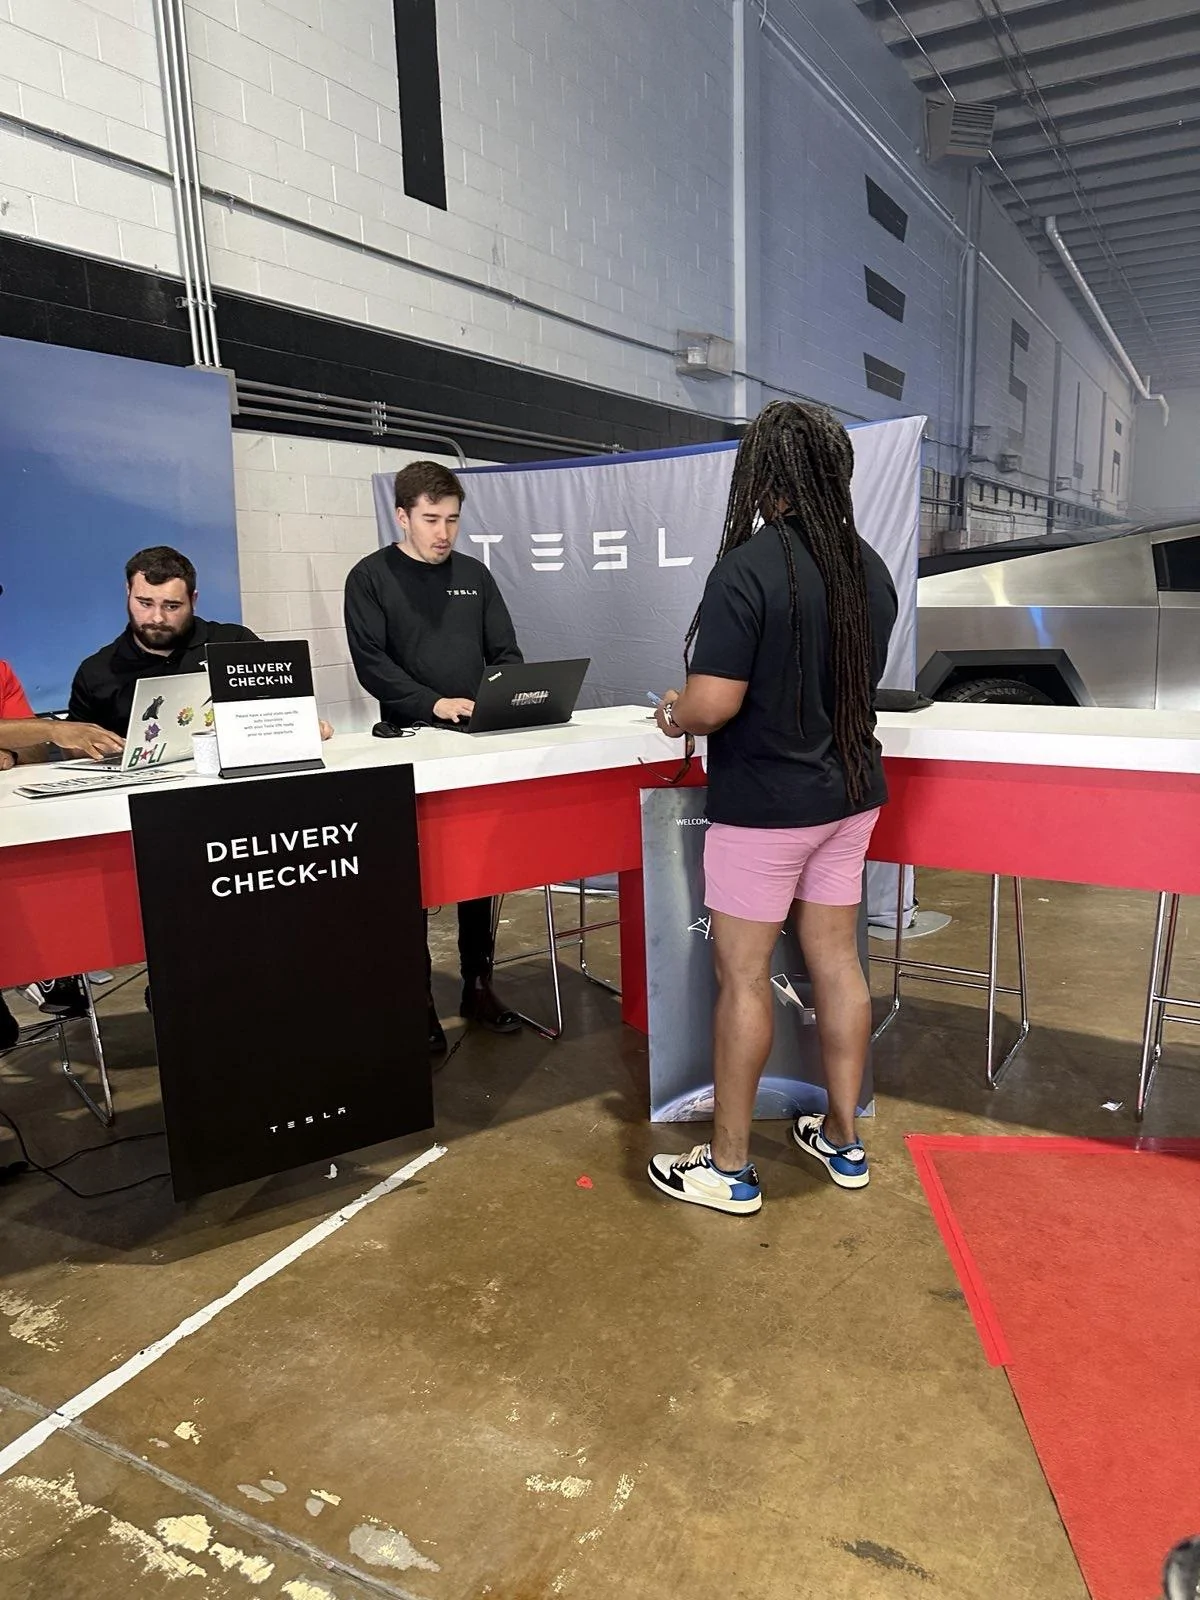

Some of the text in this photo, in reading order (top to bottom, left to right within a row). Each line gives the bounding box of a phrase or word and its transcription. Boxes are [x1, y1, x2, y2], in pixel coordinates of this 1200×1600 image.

[468, 527, 695, 572] TESL
[226, 662, 292, 675] DELIVERY
[228, 675, 294, 688] CHECK-IN
[206, 822, 359, 863] DELIVERY
[211, 855, 359, 898] CHECK-IN
[269, 1106, 347, 1134] TESLA
